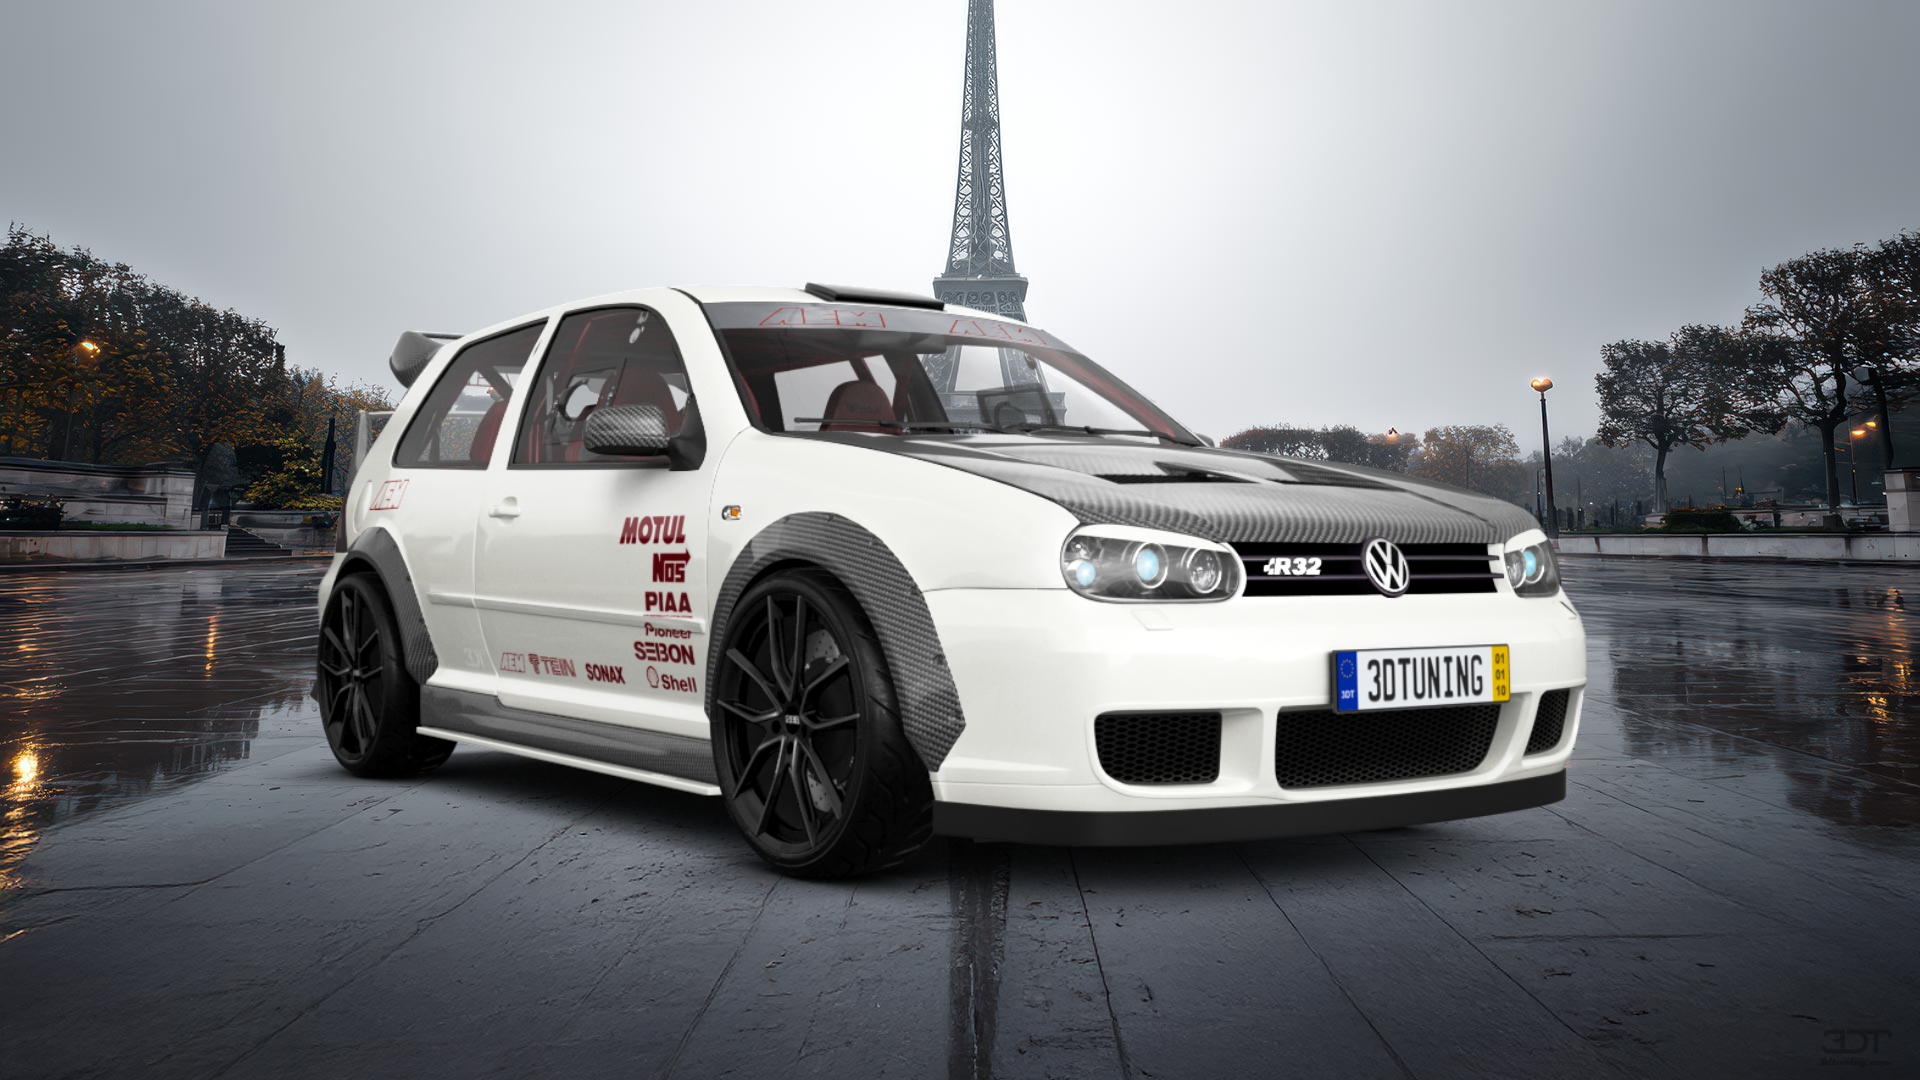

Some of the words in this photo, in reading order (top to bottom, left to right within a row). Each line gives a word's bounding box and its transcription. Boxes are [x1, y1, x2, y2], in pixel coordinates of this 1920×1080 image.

[619, 514, 687, 545] MOTUL
[644, 591, 693, 613] PIAA
[643, 621, 692, 640] Pioneer
[633, 640, 696, 666] SEBON
[1494, 652, 1506, 665] 01
[540, 655, 577, 678] TEIN
[585, 662, 627, 685] SONAX
[1495, 668, 1506, 681] 01
[660, 673, 698, 694] Shell
[1367, 654, 1484, 703] 3DTUNING
[1340, 689, 1356, 700] 3DT
[1495, 684, 1507, 697] 10
